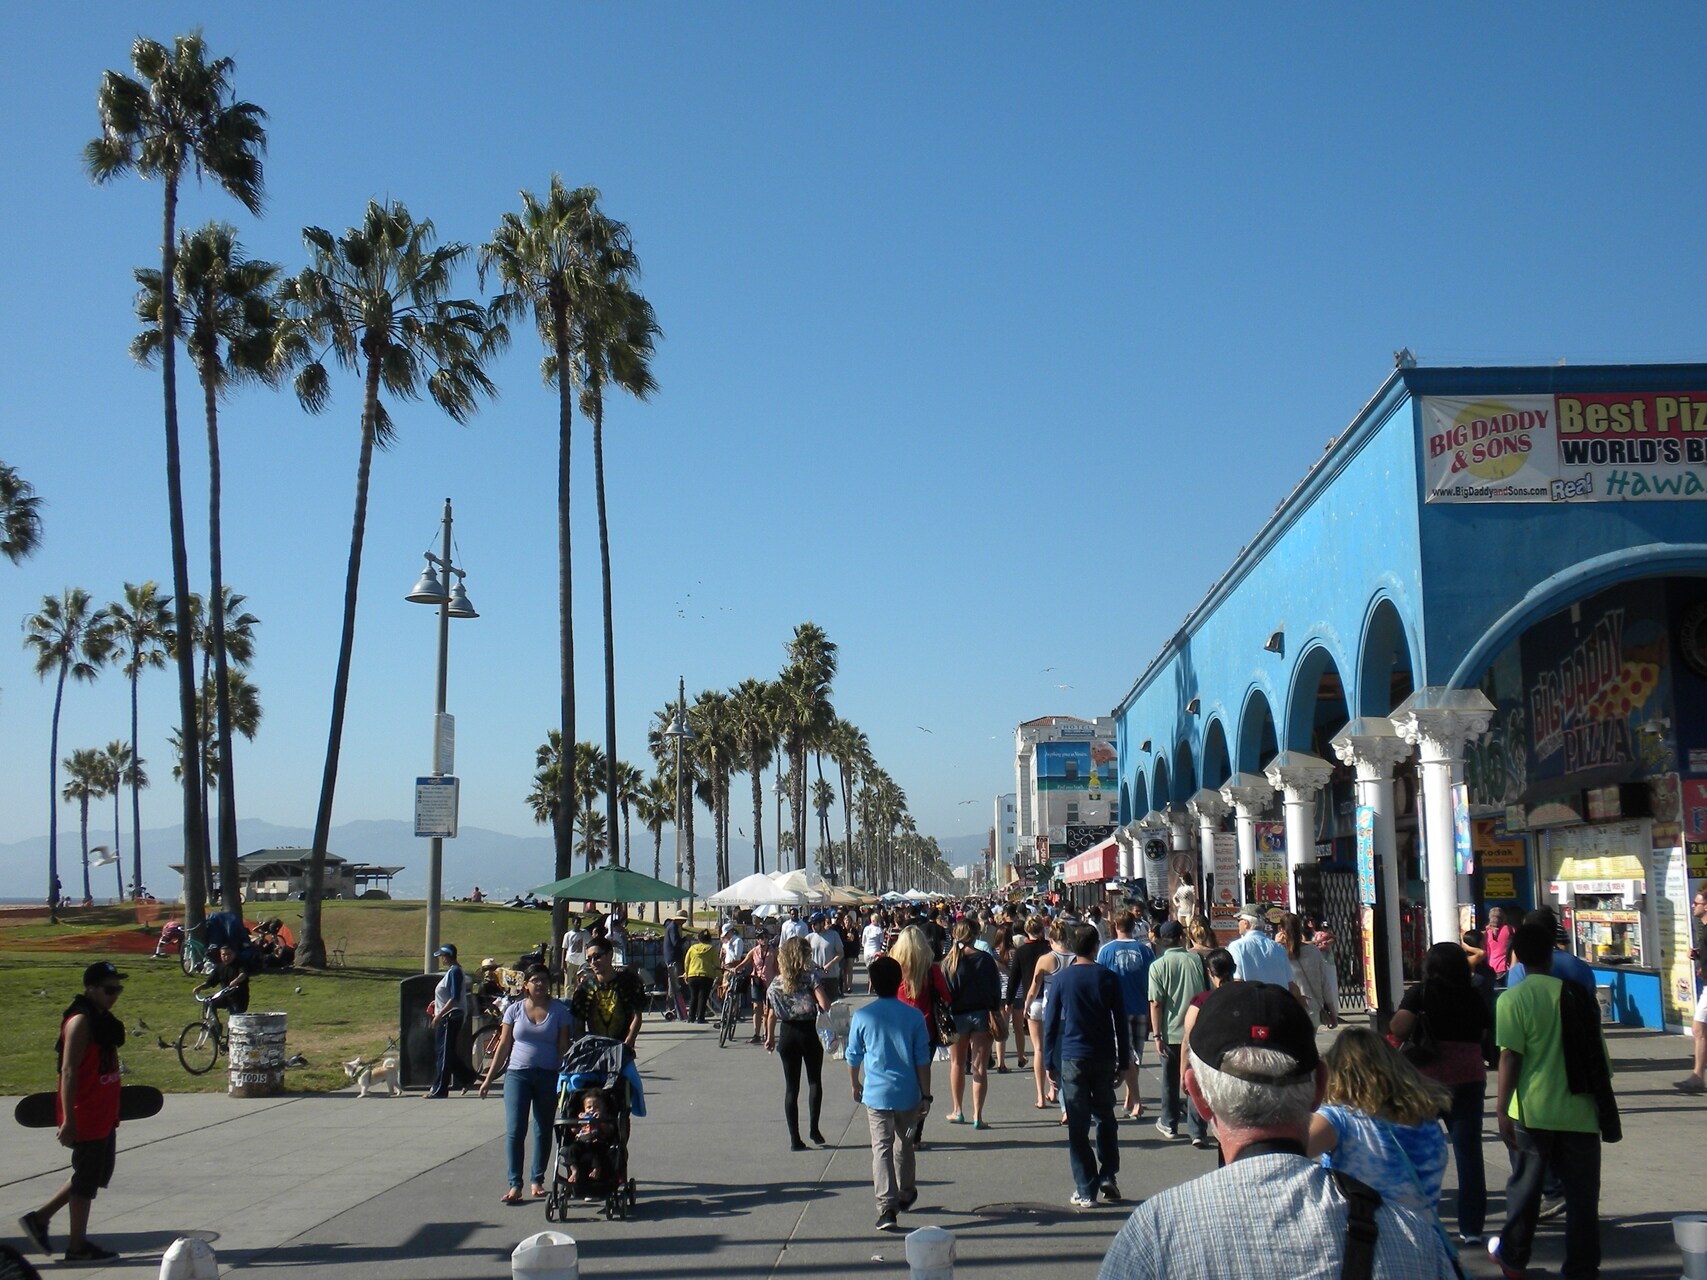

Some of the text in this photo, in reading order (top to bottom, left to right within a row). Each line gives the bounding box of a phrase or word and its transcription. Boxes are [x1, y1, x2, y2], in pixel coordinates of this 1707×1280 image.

[1559, 396, 1707, 433] Best Piz
[1430, 410, 1548, 459] BIG DADDY
[1560, 438, 1707, 465] WORLD'S B
[1451, 434, 1532, 473] & SONS
[1432, 486, 1548, 499] www.BigDaddyandSons.com
[1551, 473, 1593, 501] Real
[1366, 829, 1375, 902] TACOS
